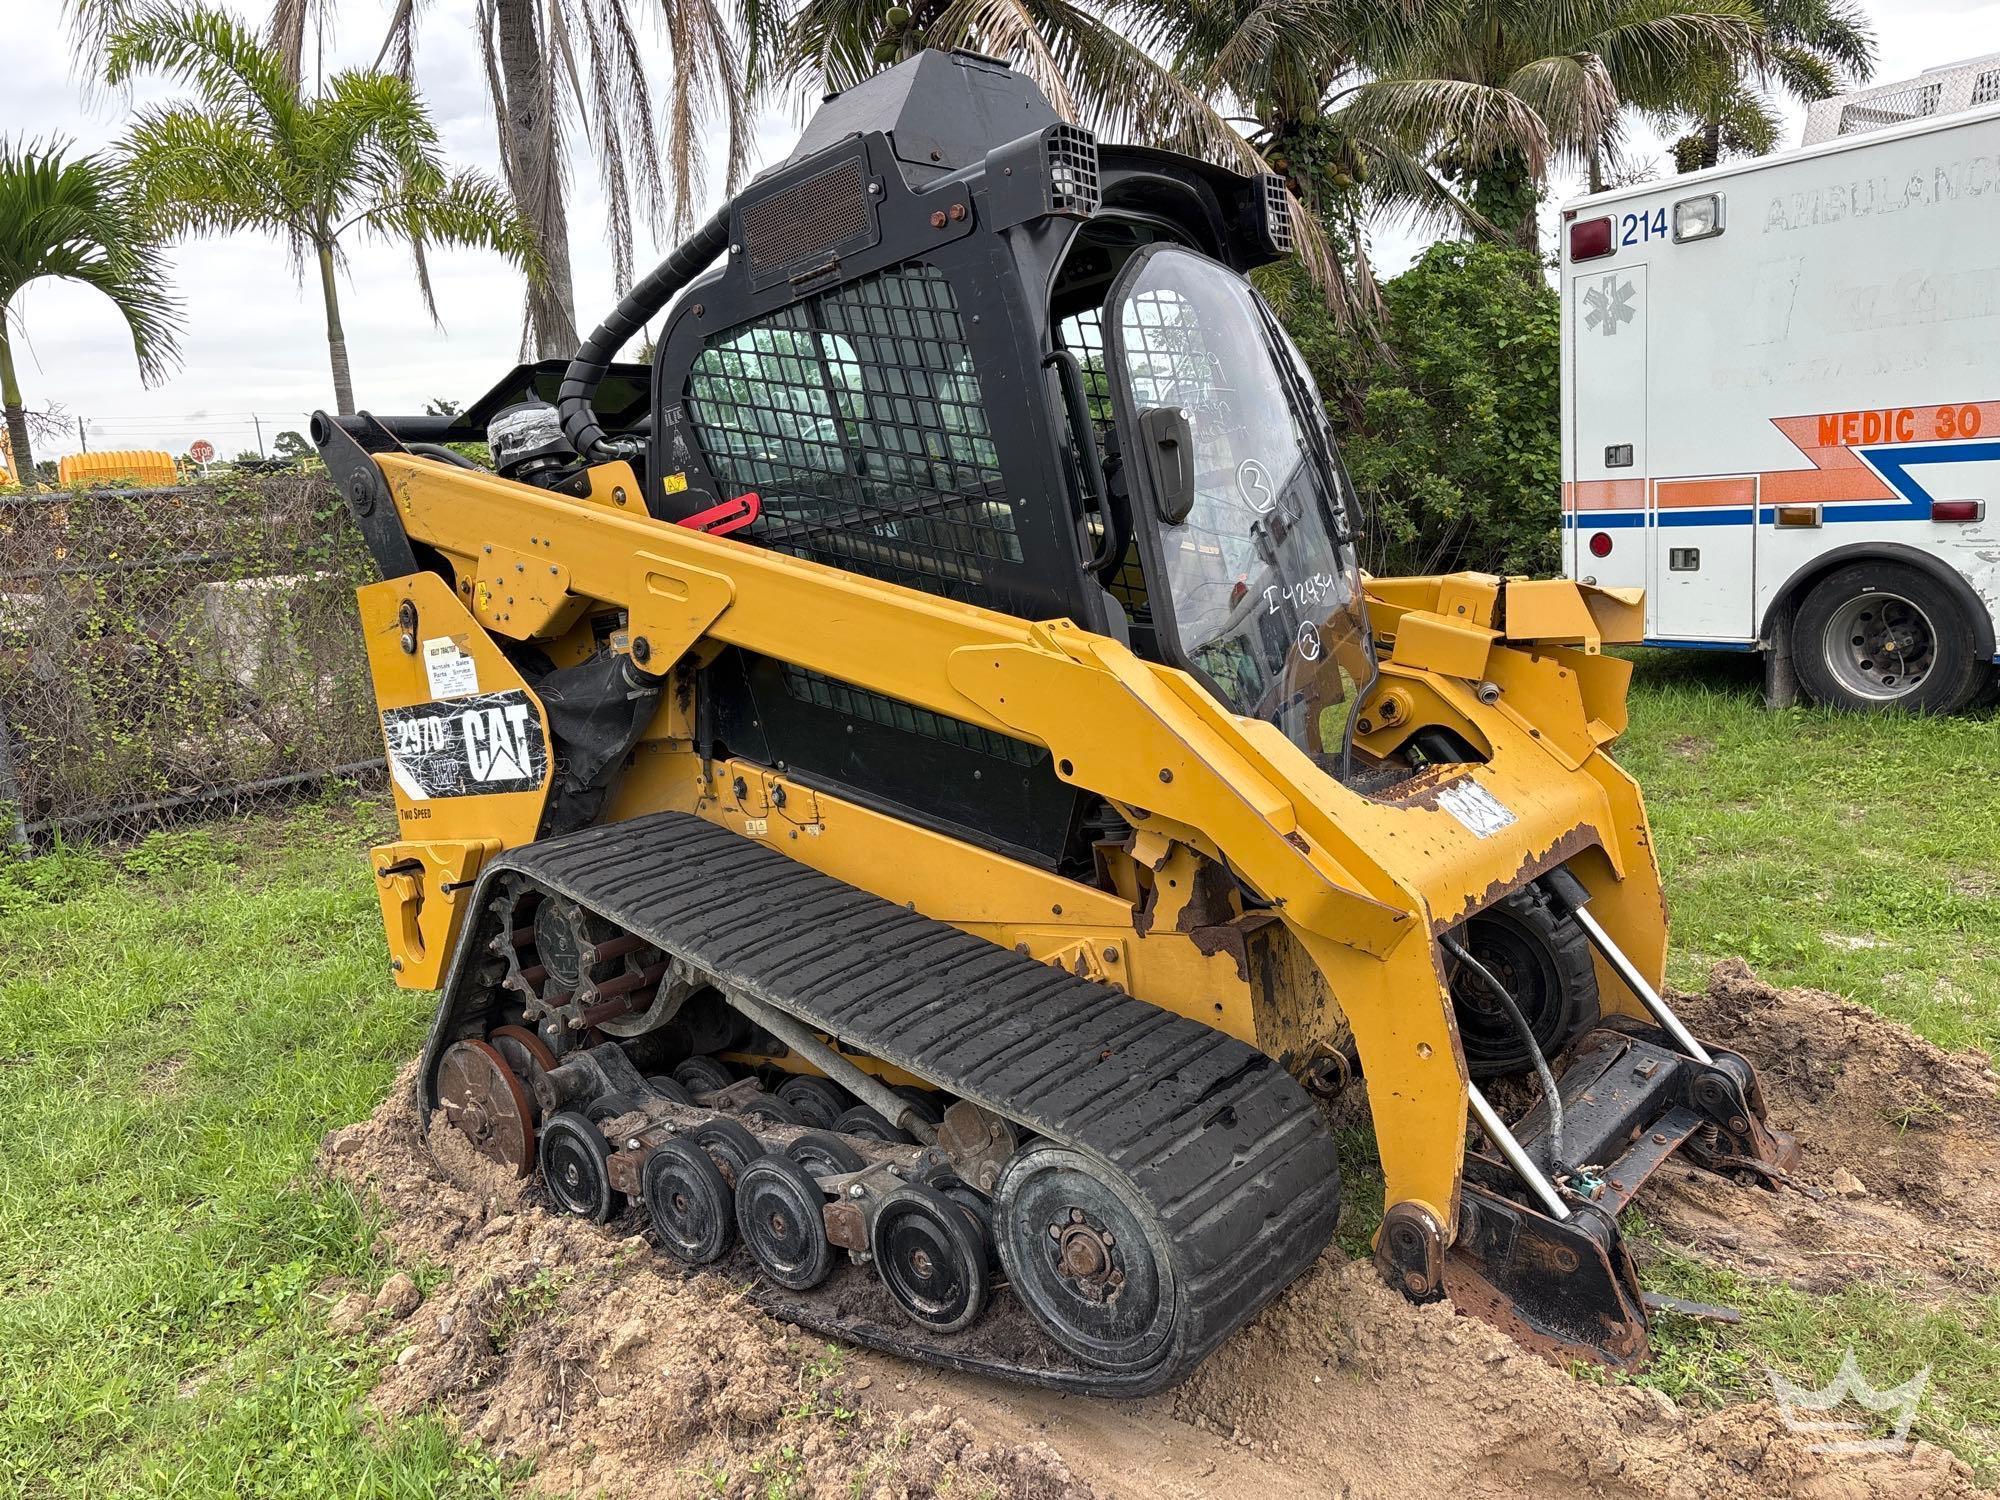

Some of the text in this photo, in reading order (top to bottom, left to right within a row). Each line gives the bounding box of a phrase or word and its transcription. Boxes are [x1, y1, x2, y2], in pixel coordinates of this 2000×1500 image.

[1763, 155, 2000, 233] AMBULANC
[1622, 207, 1668, 246] 214
[1818, 404, 1982, 447] MEDIC 30
[191, 446, 212, 457] STOP
[1244, 467, 1271, 509] 3
[462, 704, 532, 782] CAT
